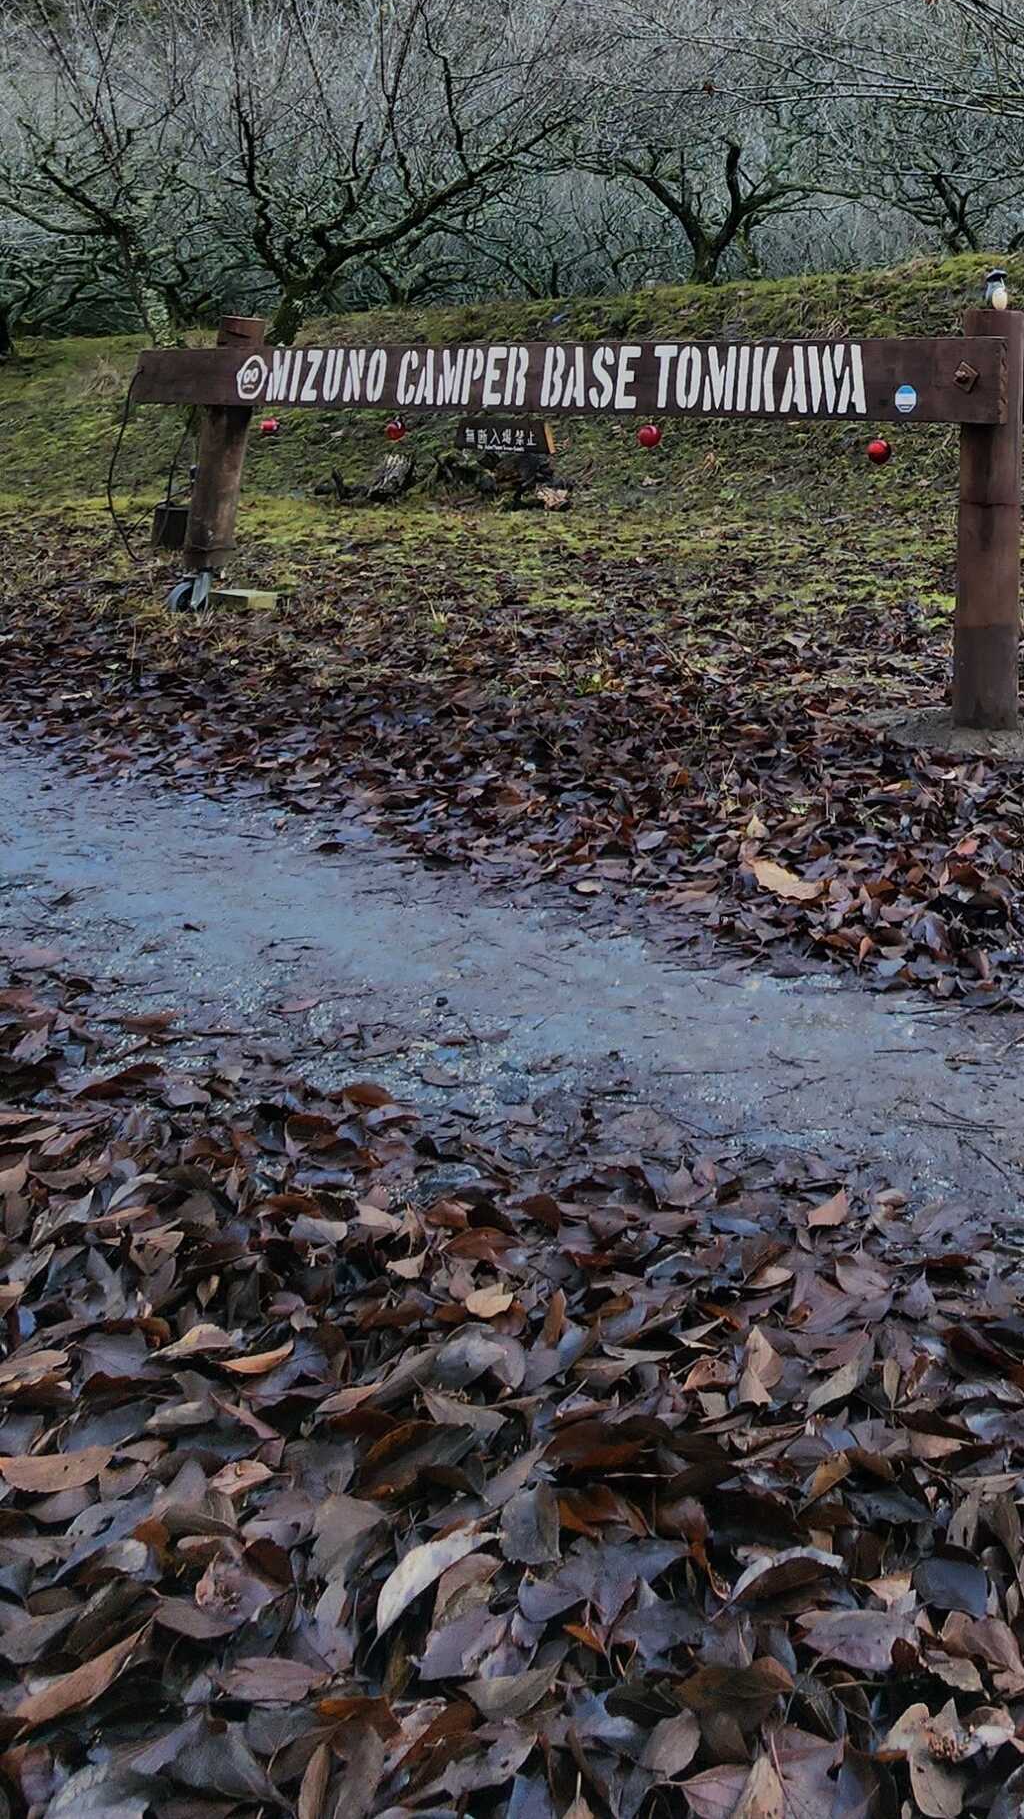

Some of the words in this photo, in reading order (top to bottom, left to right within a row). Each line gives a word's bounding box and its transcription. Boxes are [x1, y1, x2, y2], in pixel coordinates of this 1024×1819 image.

[265, 348, 388, 403] MIZUNO
[396, 346, 530, 406] CAMPER
[540, 345, 642, 410] BASE
[654, 344, 867, 415] TOMIKAWA
